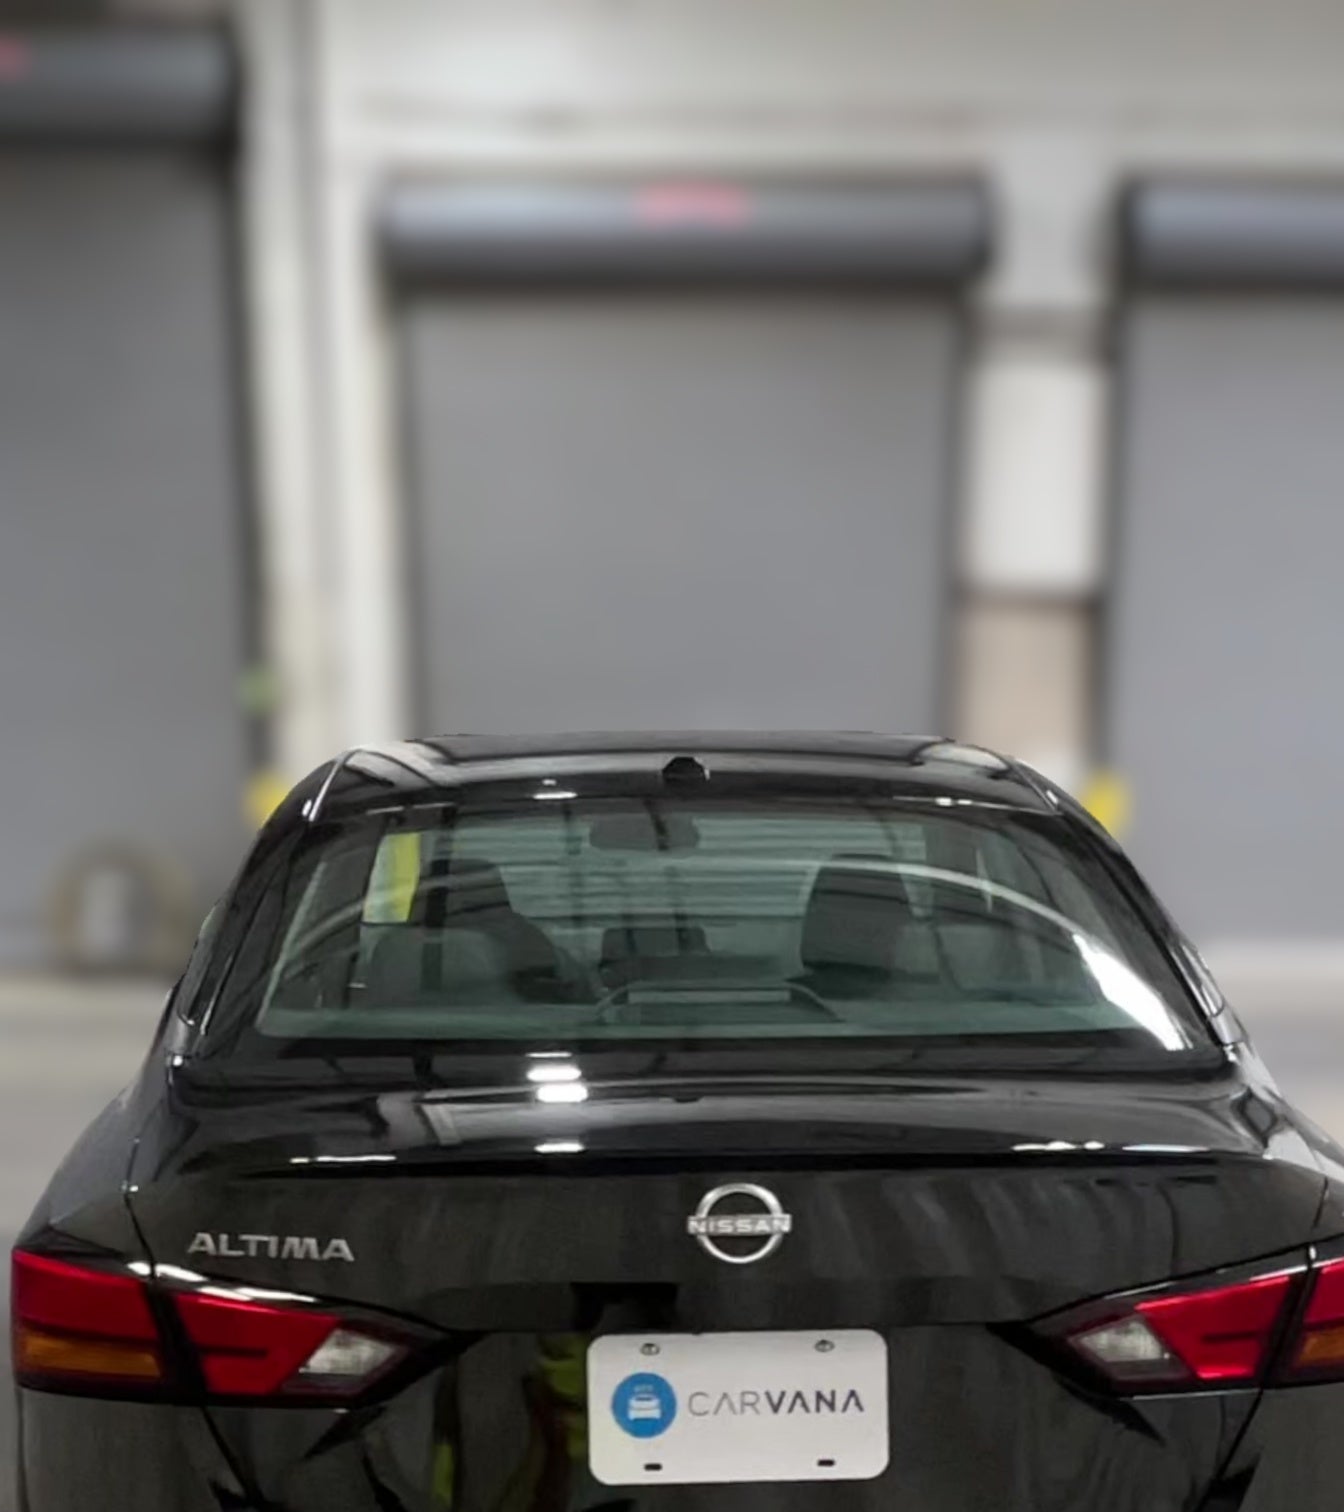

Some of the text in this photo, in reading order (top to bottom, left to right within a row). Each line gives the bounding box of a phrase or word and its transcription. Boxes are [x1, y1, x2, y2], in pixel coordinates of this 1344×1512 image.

[688, 1215, 791, 1235] NISSAN
[187, 1232, 355, 1262] ALTIMA
[688, 1389, 865, 1417] CARVANA
